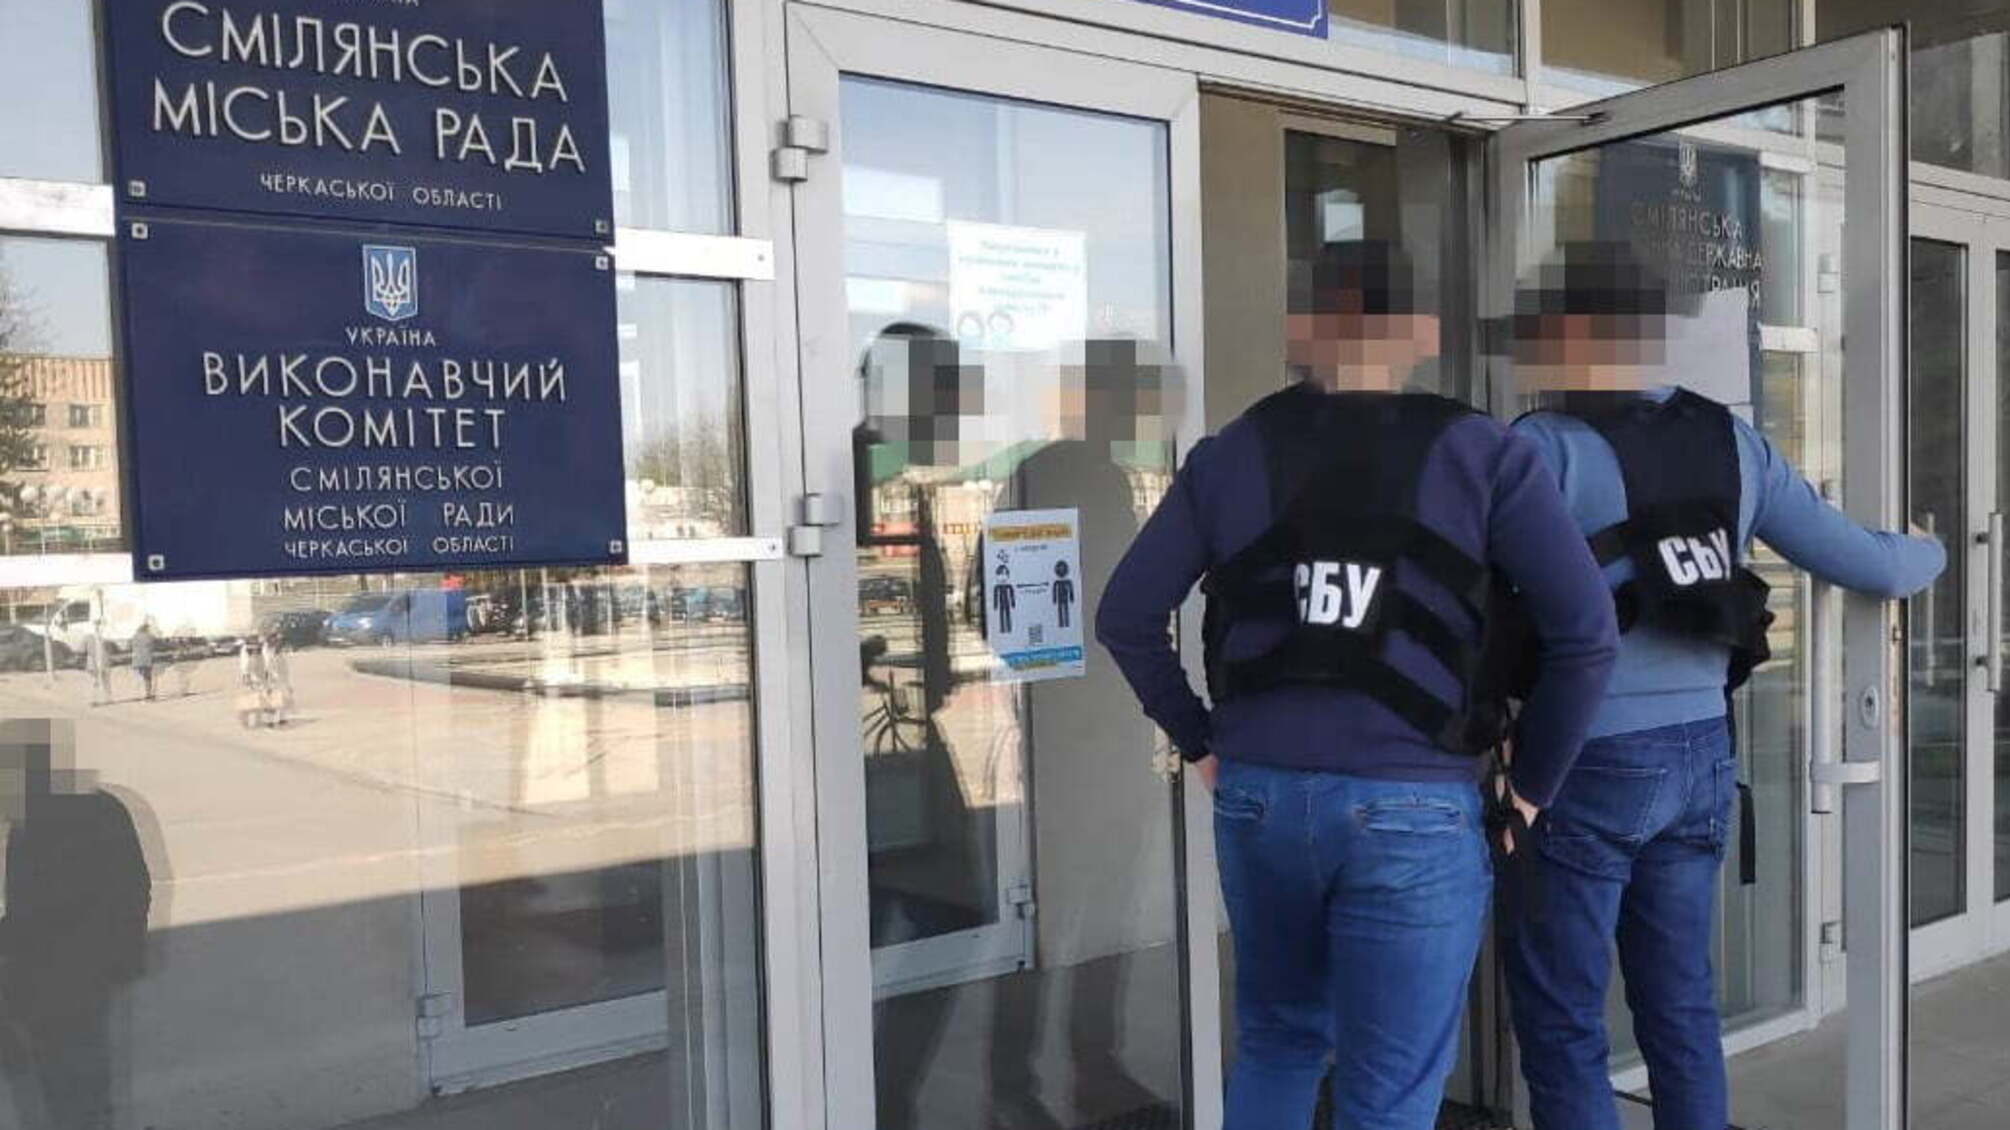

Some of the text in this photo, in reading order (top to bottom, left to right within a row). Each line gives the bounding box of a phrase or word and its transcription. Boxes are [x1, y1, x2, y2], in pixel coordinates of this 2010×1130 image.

[162, 0, 569, 102] СМІЛЯНСЬКА
[153, 78, 587, 174] МІСЬКА РАДА
[259, 172, 502, 210] ЧЕРКАСЬКОЇ ОБЛАСТІ
[345, 326, 437, 347] УКРАЇНА
[202, 352, 567, 402] ВИКОНАВЧИЙ
[279, 405, 506, 449] КОМІТЕТ
[290, 459, 503, 492] СМІЛЯНСЬКОЇ
[284, 498, 514, 530] МІСЬКОЇ РАДИ
[284, 535, 514, 560] ЧЕРКАСЬКОЇ ОБЛАСТІ
